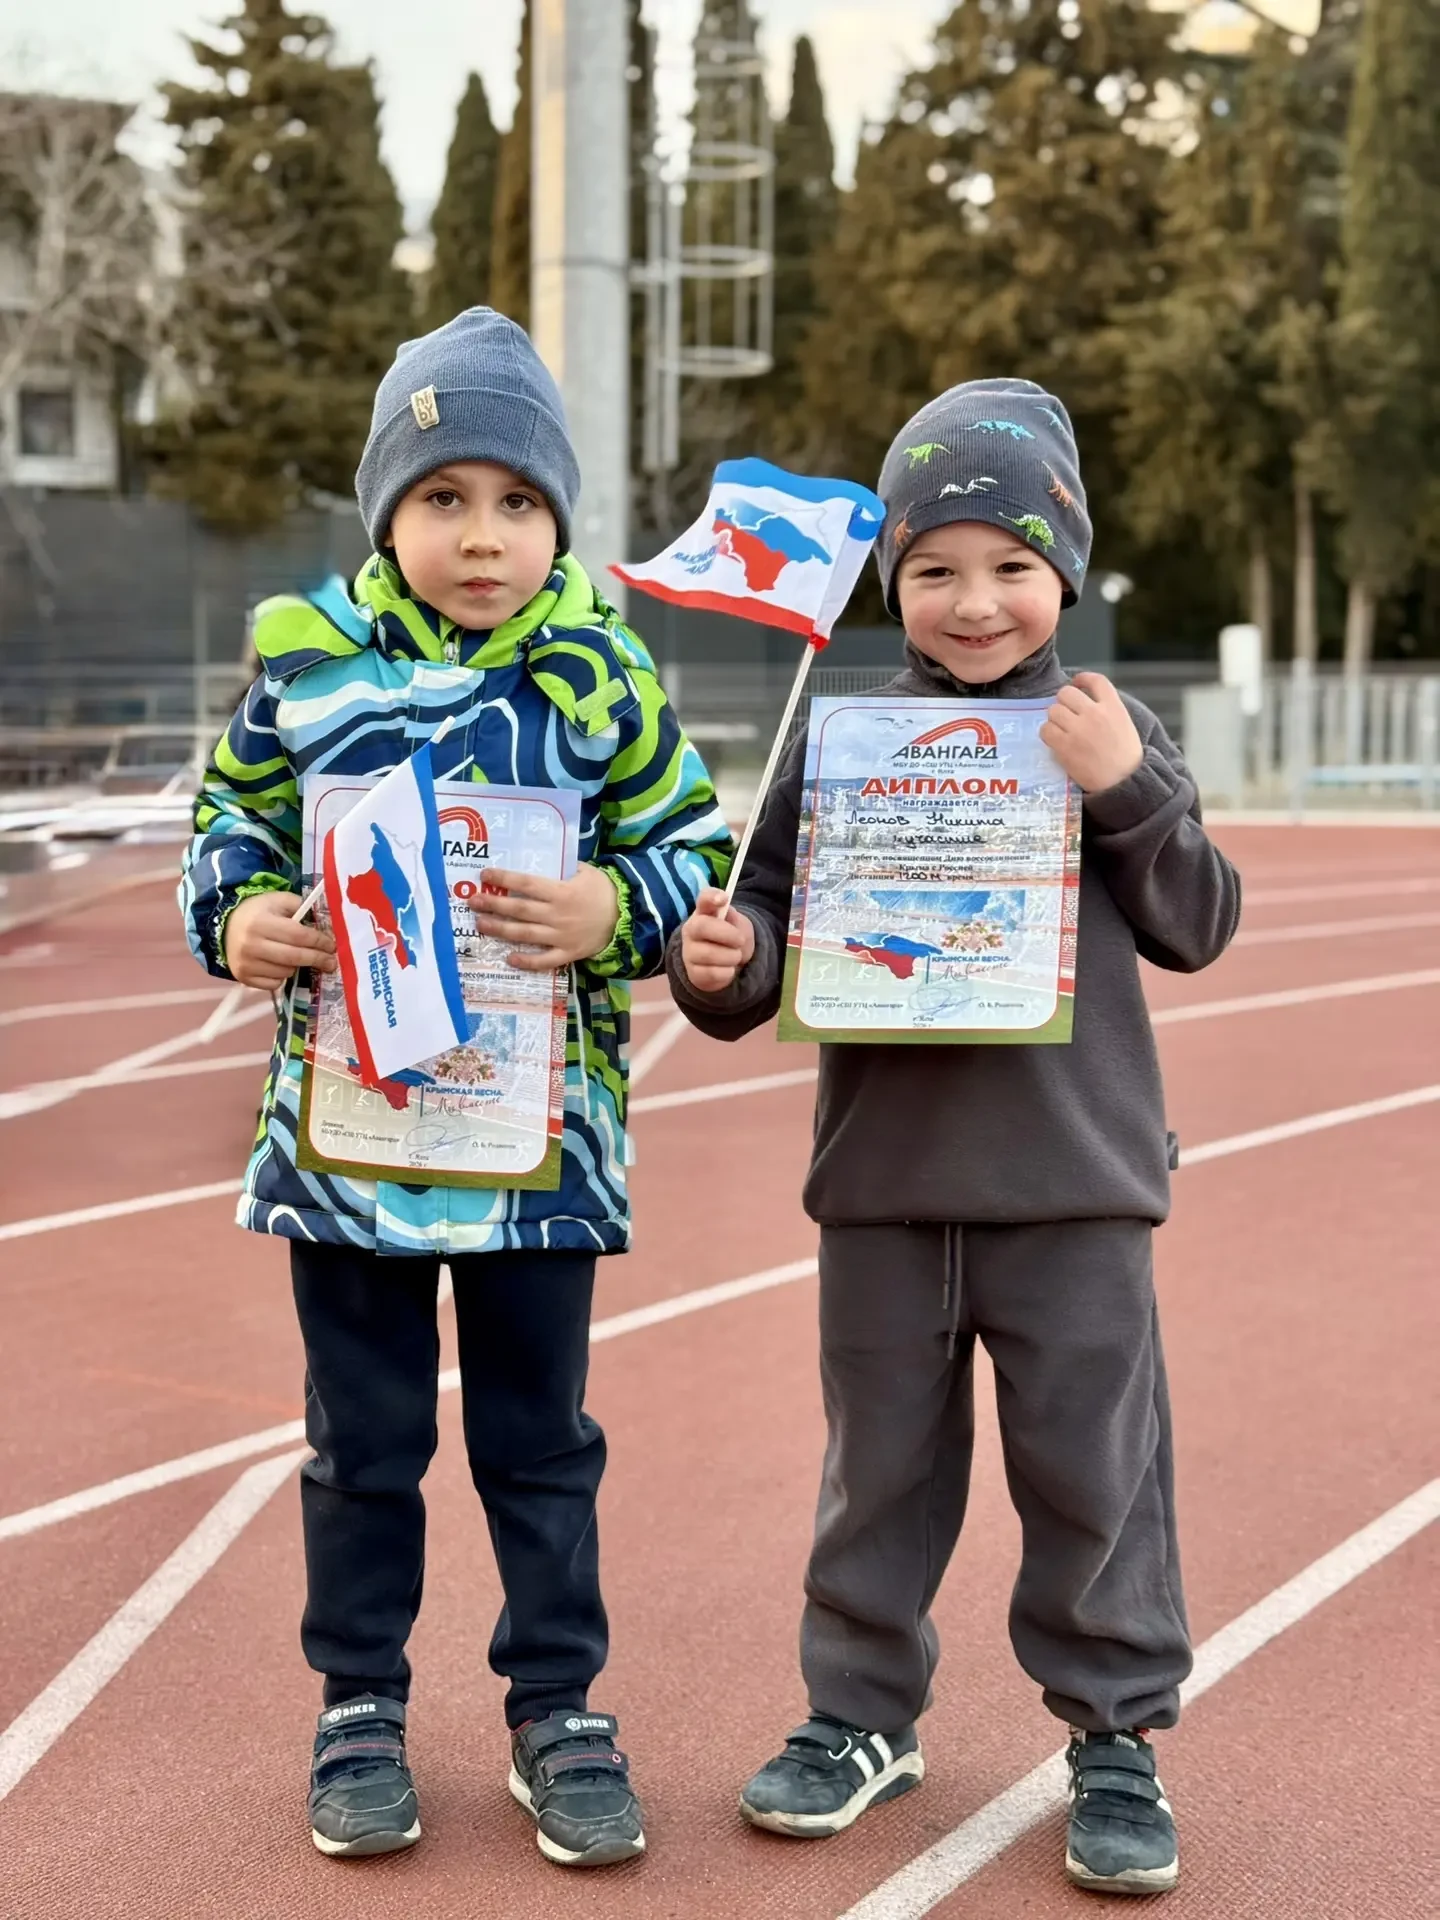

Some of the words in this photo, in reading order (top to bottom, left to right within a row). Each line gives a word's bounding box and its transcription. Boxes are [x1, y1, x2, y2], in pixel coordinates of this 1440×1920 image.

[891, 745, 998, 759] АВАНГАРД
[861, 778, 1019, 797] ДИПЛОМ
[903, 800, 979, 808] награждается
[845, 809, 911, 826] Леонов
[926, 811, 1005, 827] Никита
[932, 955, 980, 963] КРЫМСКАЯ
[368, 953, 382, 1000] ВЕСНА
[379, 949, 397, 1028] КРЫМСКАЯ
[426, 1086, 473, 1094] КРЫМСКАЯ
[343, 1703, 376, 1717] BIKER
[581, 1719, 610, 1728] BIKER
